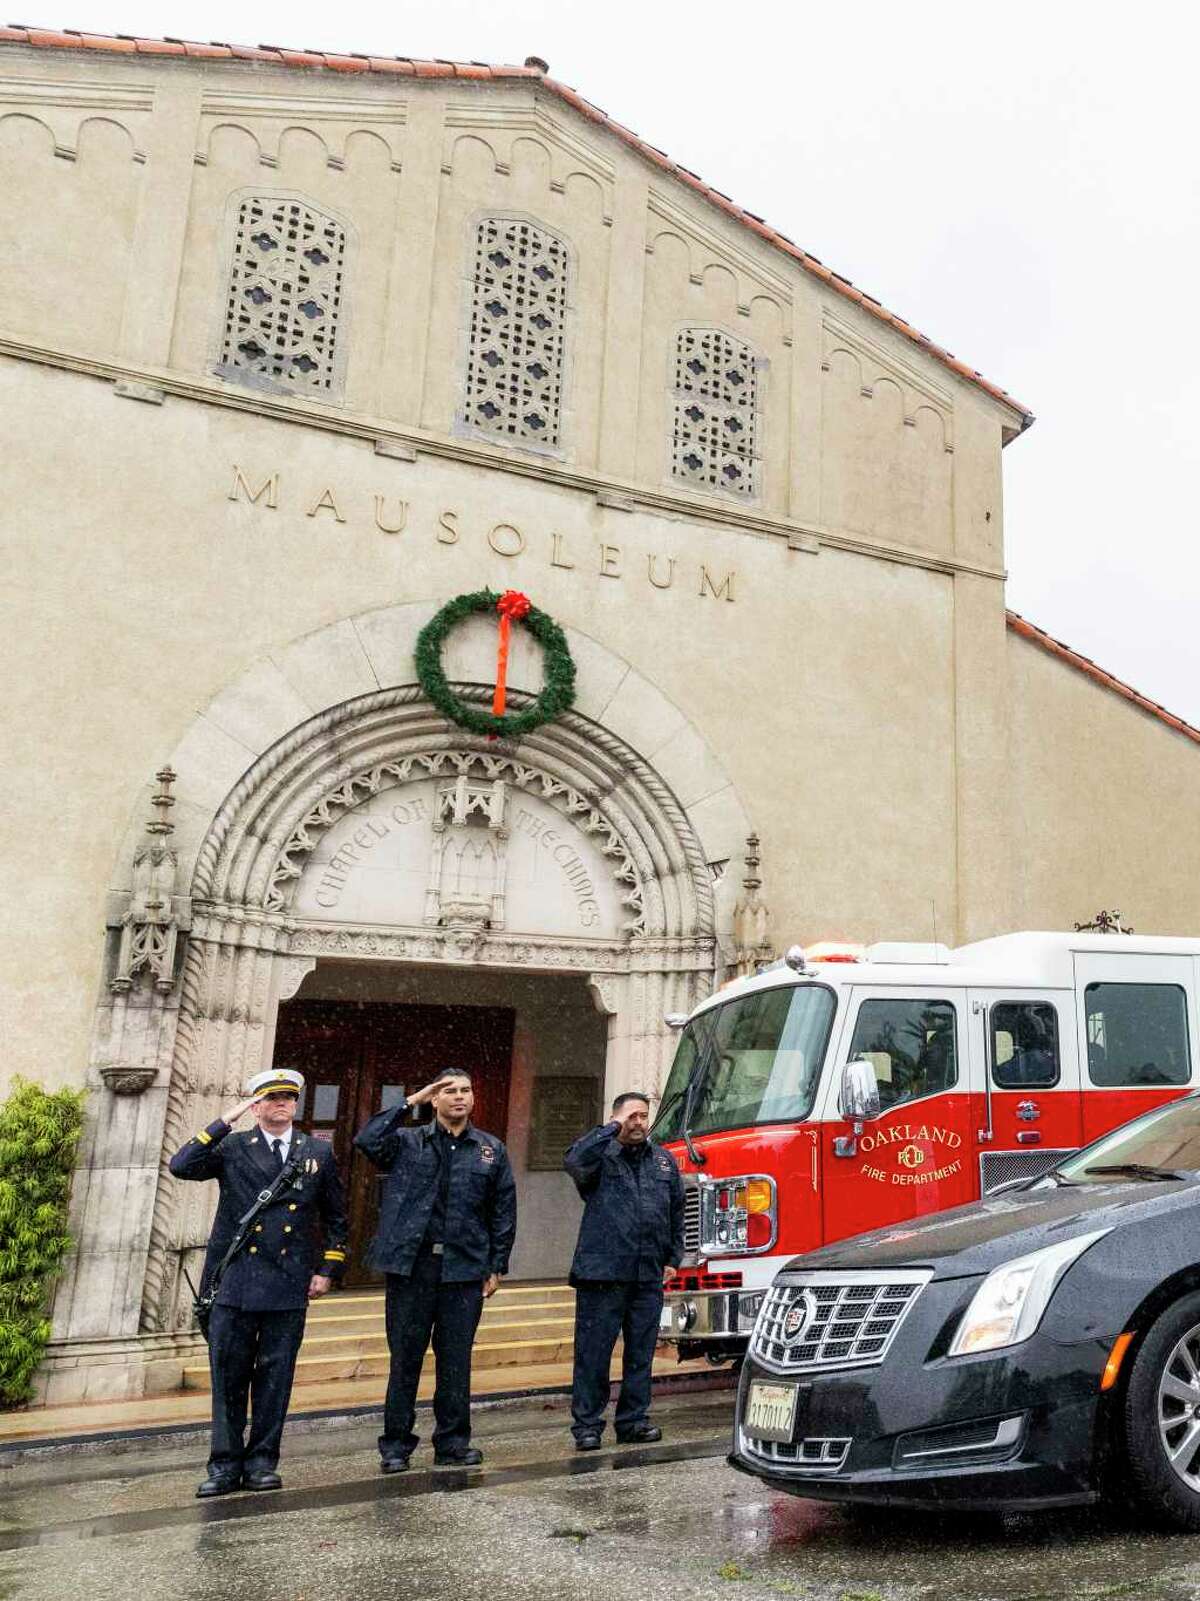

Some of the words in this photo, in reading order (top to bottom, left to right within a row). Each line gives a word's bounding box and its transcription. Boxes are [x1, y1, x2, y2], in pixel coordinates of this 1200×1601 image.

[227, 463, 737, 603] MAUSOLEUM
[315, 819, 391, 908] CHAPEL
[393, 798, 424, 825] OF
[860, 1124, 962, 1152] OAKLAND
[860, 1164, 886, 1182] FIRE
[891, 1159, 963, 1185] DEPARTMENT
